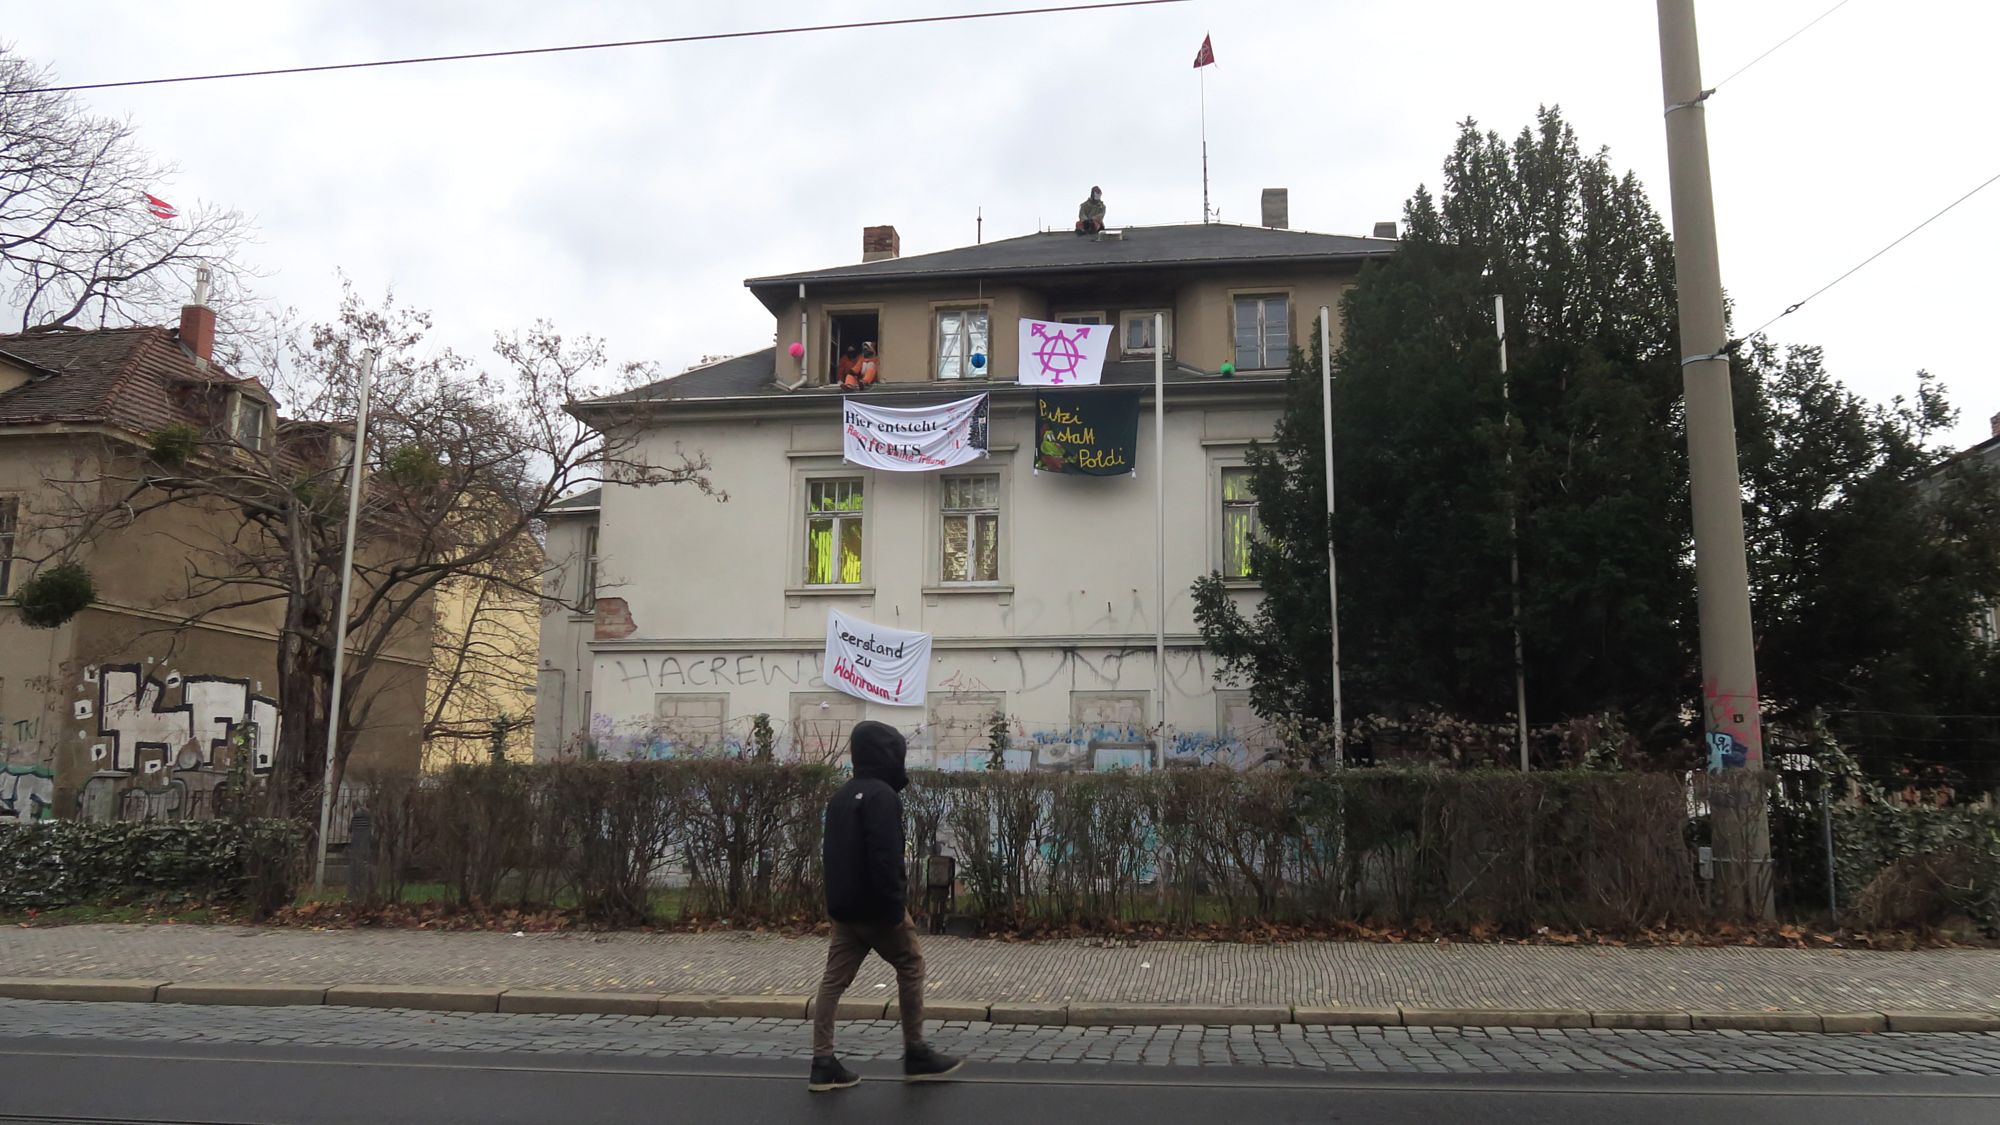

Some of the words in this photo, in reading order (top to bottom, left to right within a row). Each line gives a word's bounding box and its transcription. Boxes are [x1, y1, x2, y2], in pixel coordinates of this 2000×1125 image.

[845, 410, 873, 429] Hier
[877, 419, 937, 434] entsteht
[1039, 398, 1083, 425] Putzi
[856, 436, 922, 457] NICHTS
[1056, 427, 1095, 445] statt
[1079, 447, 1125, 468] Poldi
[834, 619, 904, 659] Leerstand
[855, 653, 872, 668] zu
